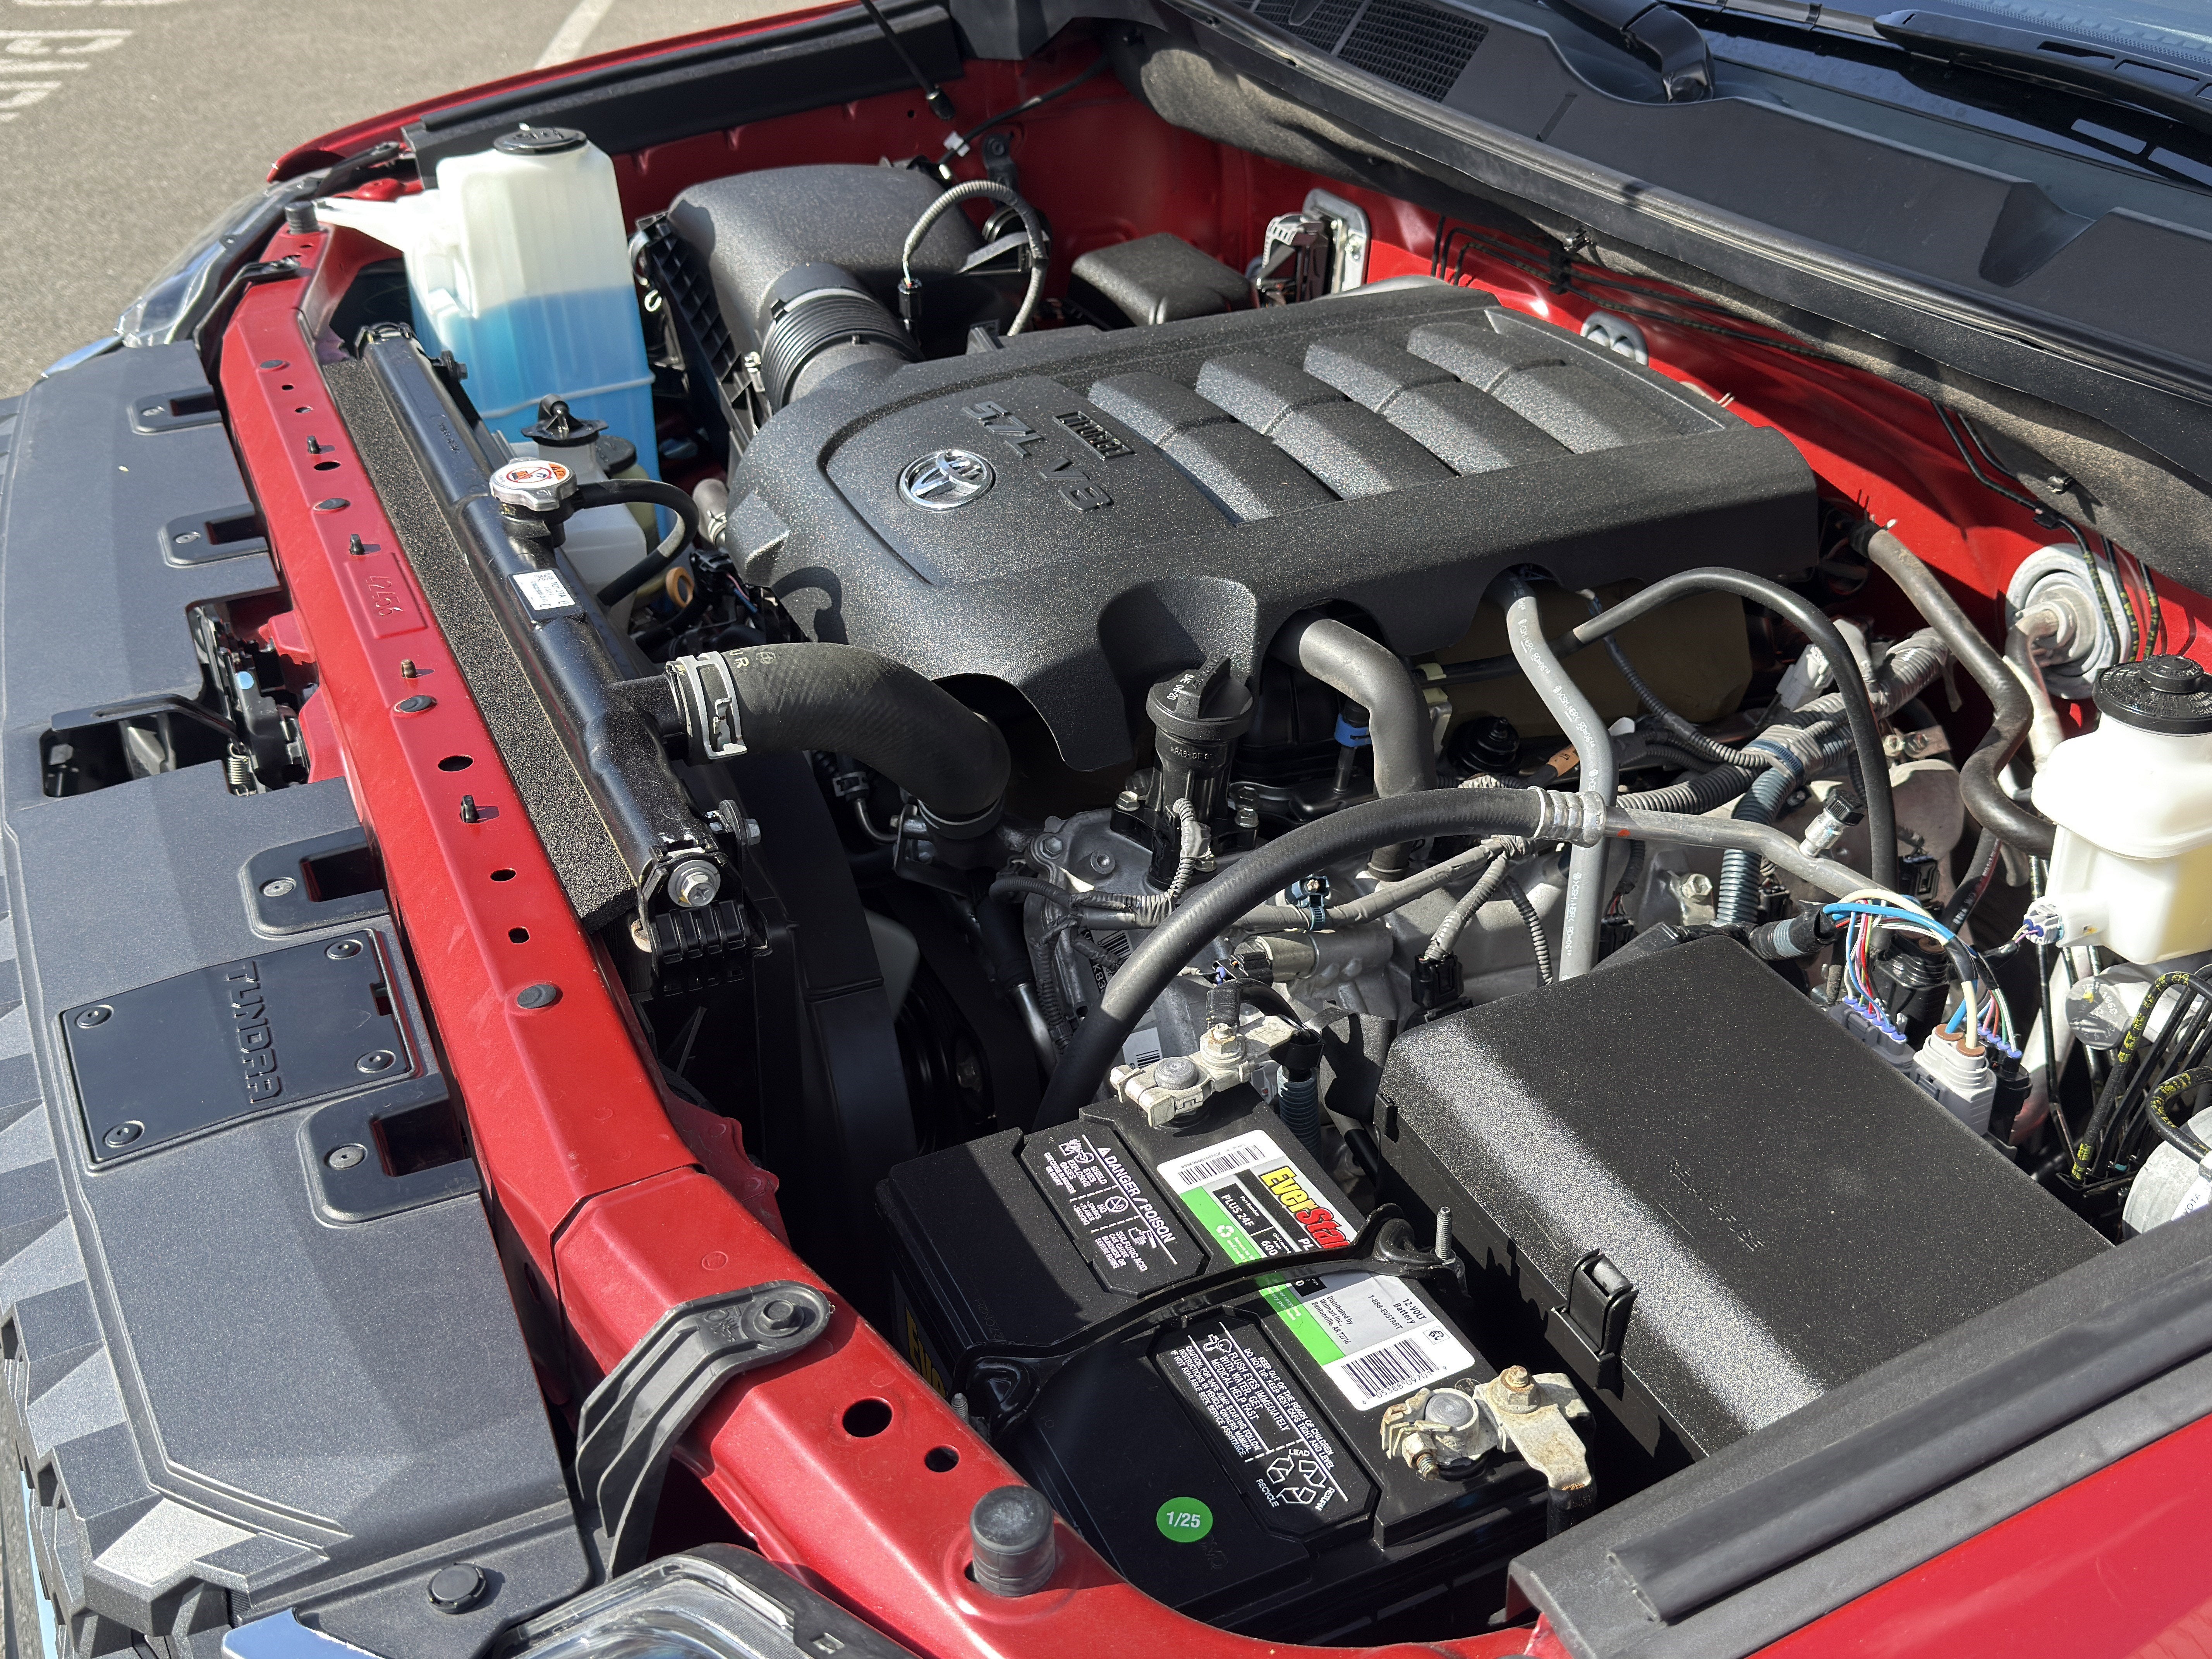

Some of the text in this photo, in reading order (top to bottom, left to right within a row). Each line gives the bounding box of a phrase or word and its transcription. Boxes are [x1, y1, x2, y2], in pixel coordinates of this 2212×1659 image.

[1040, 457, 1114, 512] V8
[1167, 672, 1195, 699] SAE 0W-20
[227, 960, 283, 1104] TUNDRA
[1050, 1160, 1062, 1173] CAUSE
[1057, 1171, 1076, 1194] BLINDNESS
[1060, 1162, 1076, 1180] GASES
[1067, 1159, 1091, 1187] EXPLOSIVE
[1083, 1168, 1096, 1182] EYES
[1091, 1166, 1107, 1184] SHIELD
[1097, 1204, 1107, 1213] NO
[1104, 1156, 1140, 1197] DANGER
[1139, 1204, 1176, 1243] POISON
[1221, 1194, 1254, 1226] PLUS 24F
[1246, 1203, 1259, 1216] Number
[1095, 1238, 1120, 1269] SEVERE BURNS
[1102, 1236, 1121, 1259] BLINDNESS
[1109, 1233, 1129, 1258] CAN CAUSE
[1116, 1231, 1147, 1272] SULFURIC ACID
[1261, 1240, 1278, 1255] 600
[1279, 1240, 1291, 1254] Cranking
[1298, 1238, 1313, 1250] PL
[1320, 1299, 1340, 1318] Walmart
[1327, 1296, 1350, 1319] Distributed
[1368, 1295, 1403, 1329] 1-888-EVSTART
[1393, 1303, 1415, 1323] Battery
[1403, 1298, 1427, 1319] 12-VOLT
[1312, 1302, 1333, 1326] Bentonville,
[1337, 1332, 1351, 1344] 72716
[1211, 1358, 1259, 1419] MEDICAL HELP FAST
[1220, 1355, 1263, 1409] WITH WATER. GET
[1228, 1352, 1290, 1431] FLUSH EYES IMMEDIATELY
[1376, 1383, 1403, 1398] 05388
[1406, 1371, 1432, 1385] 09701
[1174, 1356, 1186, 1366] NOT
[1182, 1367, 1202, 1391] AVAILABLE
[1199, 1391, 1211, 1405] SEEK
[1207, 1405, 1225, 1425] SERVICE
[1221, 1425, 1246, 1457] ASSISTANCE.
[1179, 1349, 1205, 1382] INSTRUCTIONS
[1206, 1389, 1223, 1410] VEHICLE
[1220, 1409, 1238, 1430] OWNERS
[1235, 1431, 1252, 1453] MANUAL.
[1186, 1346, 1262, 1451] CAUTION: FOR SAFE JUMP STARTING FOLLOW
[1244, 1348, 1254, 1357] DO
[1250, 1357, 1262, 1368] NOT
[1266, 1380, 1280, 1393] KEEP
[1277, 1394, 1291, 1407] VENT
[1287, 1408, 1301, 1422] CAPS
[1298, 1422, 1314, 1439] TIGHT
[1309, 1440, 1322, 1452] AND
[1319, 1452, 1334, 1470] LEVEL
[1258, 1357, 1271, 1369] KEEP
[1269, 1370, 1281, 1381] OUT
[1283, 1390, 1295, 1402] THE
[1291, 1401, 1308, 1420] REACH
[1311, 1428, 1334, 1456] CHILDREN
[1288, 1447, 1311, 1458] LEAD
[1256, 1478, 1279, 1508] RECYCLE
[1315, 1486, 1336, 1511] RETURN
[1167, 1511, 1200, 1527] 1/25
